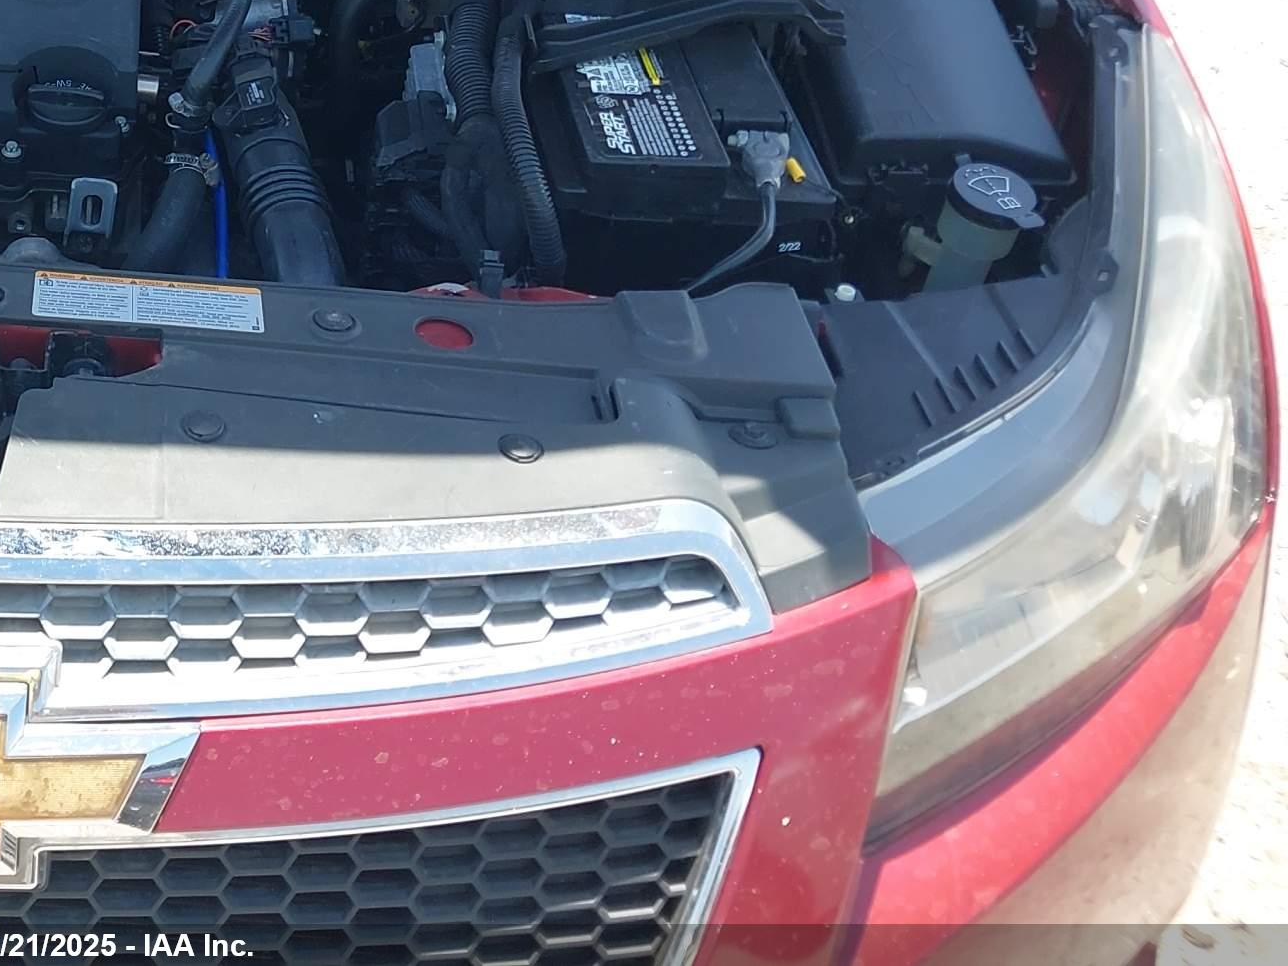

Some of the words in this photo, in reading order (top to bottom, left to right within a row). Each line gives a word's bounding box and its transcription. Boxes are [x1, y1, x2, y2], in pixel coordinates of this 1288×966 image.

[598, 111, 617, 150] SUPER
[609, 110, 637, 155] START
[778, 241, 801, 253] 2/22
